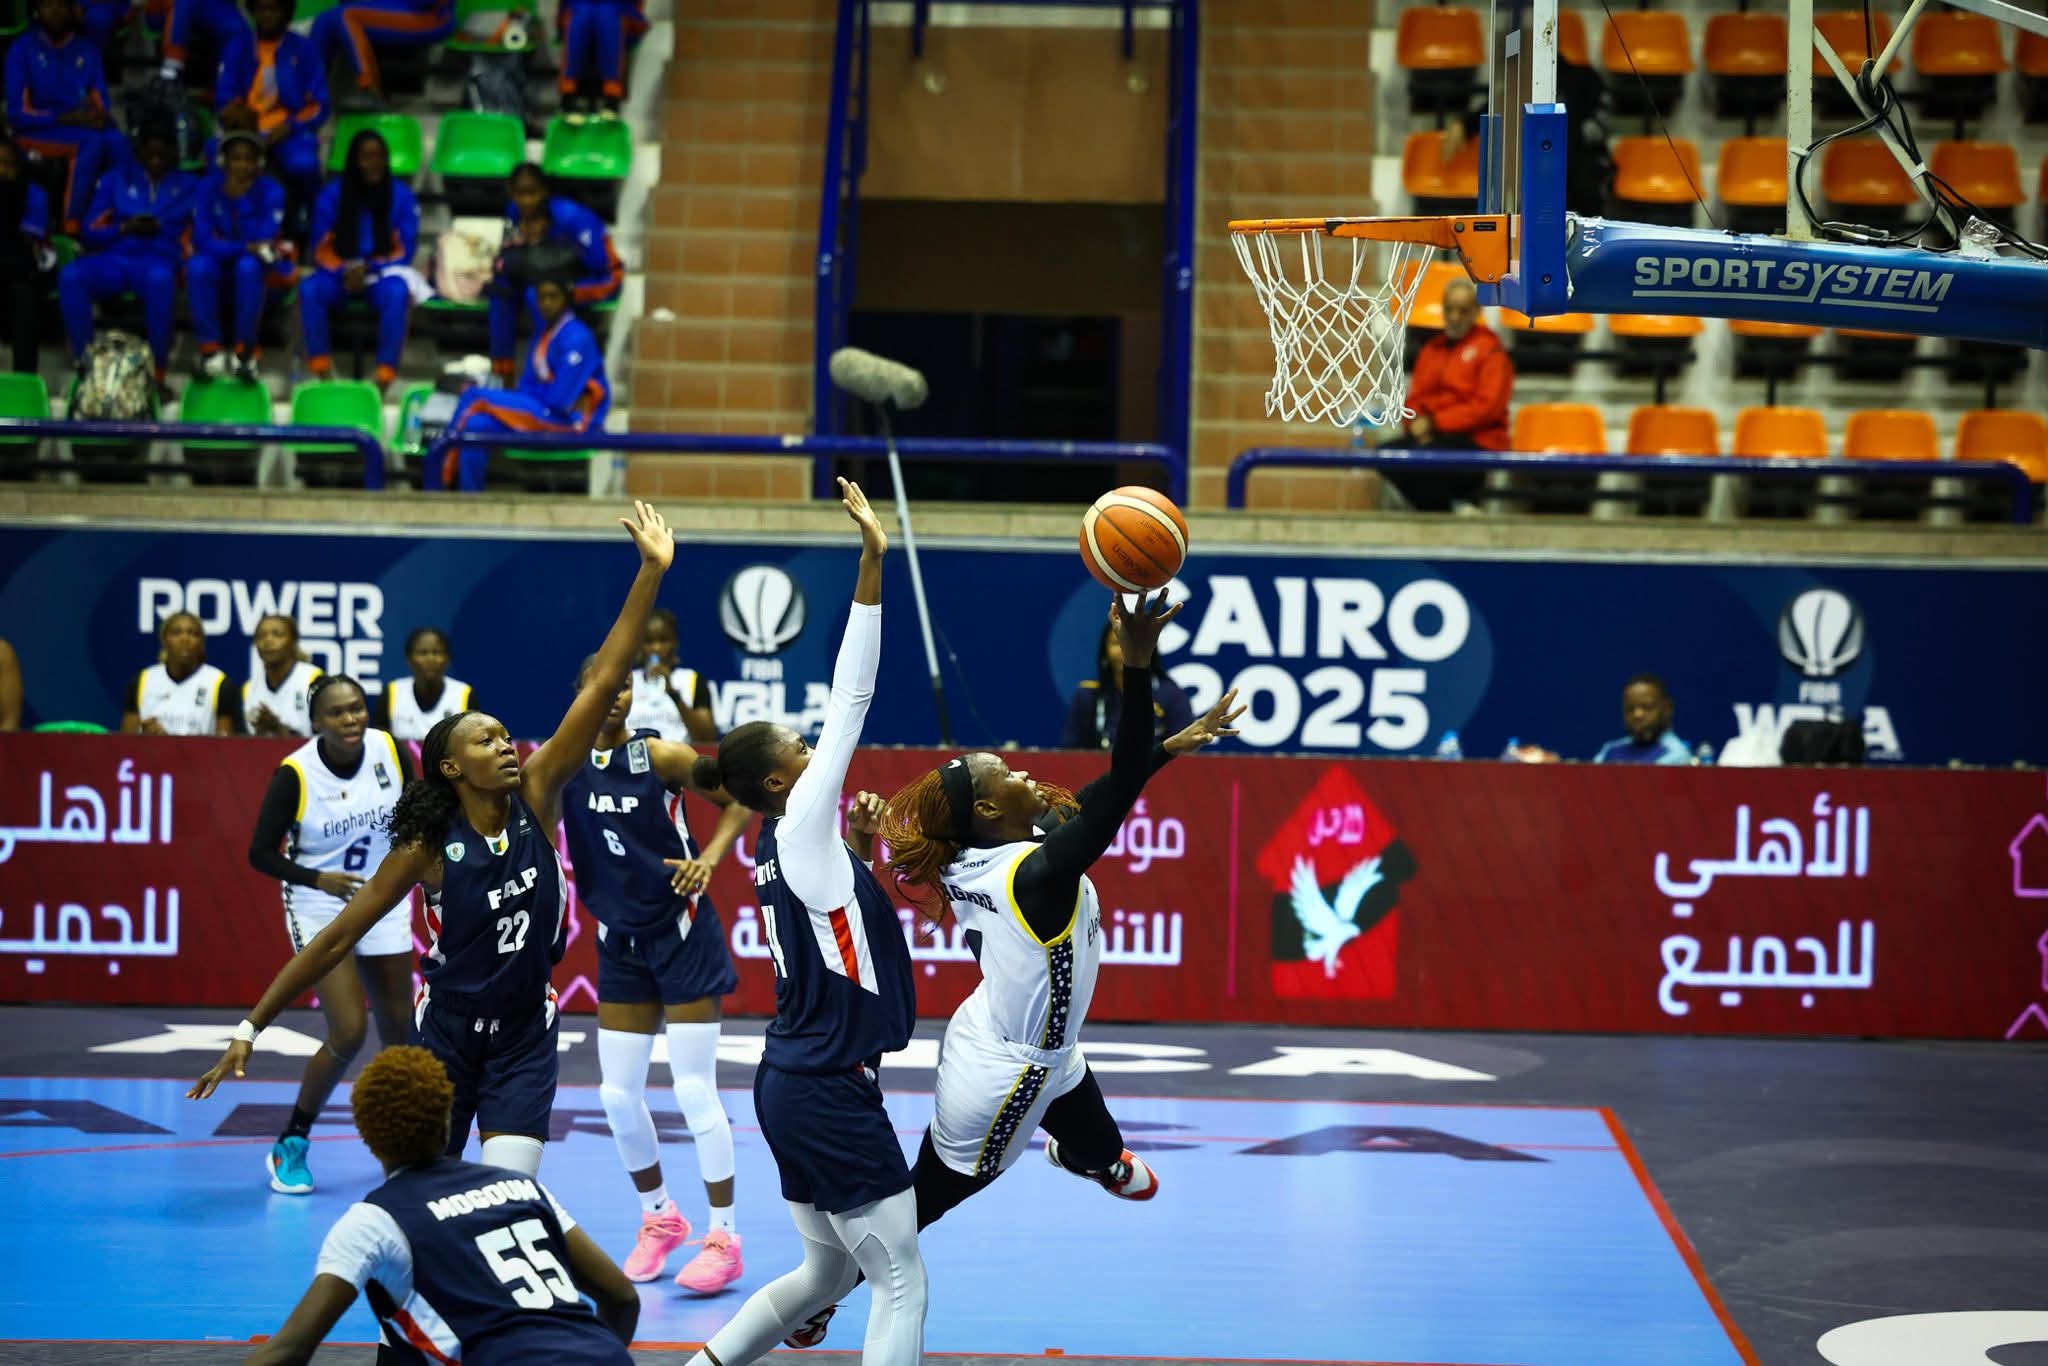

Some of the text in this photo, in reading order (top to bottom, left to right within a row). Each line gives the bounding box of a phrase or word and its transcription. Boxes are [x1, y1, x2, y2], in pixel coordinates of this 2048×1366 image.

[1633, 256, 1954, 303] SPORT SYSTEM
[138, 577, 385, 638] POWER
[1166, 662, 1429, 750] 2025
[0, 758, 173, 866] الأهل
[323, 808, 377, 838] Elephant
[602, 828, 626, 856] 6
[344, 835, 372, 871] 6
[1655, 791, 1870, 918] الأهلي
[0, 886, 180, 976] للجمي
[496, 909, 531, 954] 22
[1657, 917, 1875, 1017] للجميع
[474, 1218, 580, 1310] 55
